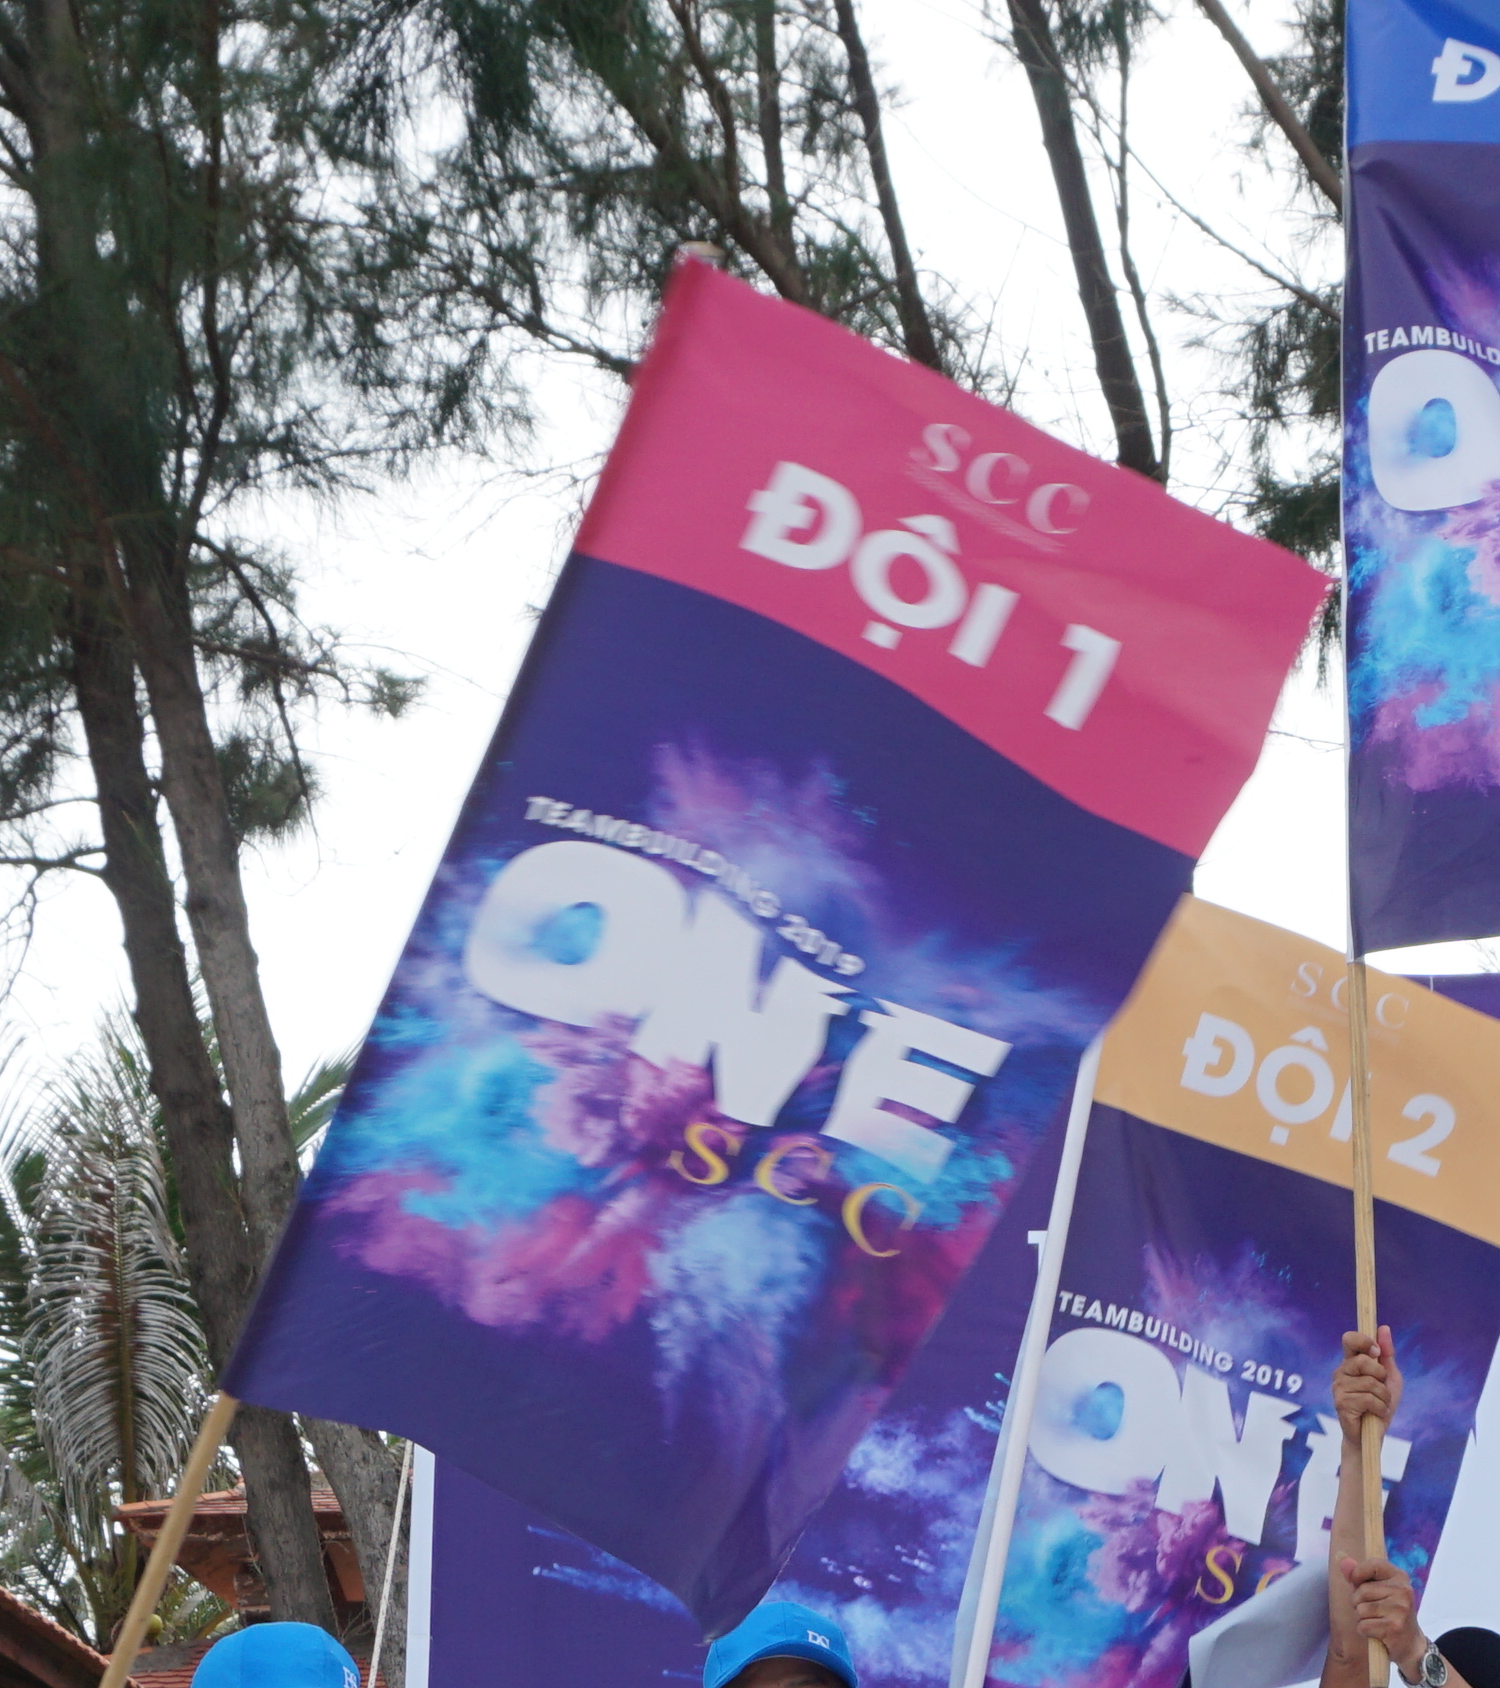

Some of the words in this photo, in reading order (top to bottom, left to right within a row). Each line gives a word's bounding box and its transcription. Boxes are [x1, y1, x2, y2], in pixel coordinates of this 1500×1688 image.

[908, 423, 1091, 534] SCC
[738, 460, 1021, 668] ĐỘI
[1043, 623, 1122, 731] 1
[524, 796, 781, 918] TEAMBUILDING
[776, 914, 865, 976] 2019
[464, 840, 1013, 1184] ONE
[668, 1122, 926, 1257] SCC
[1386, 1093, 1457, 1178] 2
[1059, 1291, 1233, 1373] TEAMBUILDING
[1240, 1359, 1303, 1395] 2019
